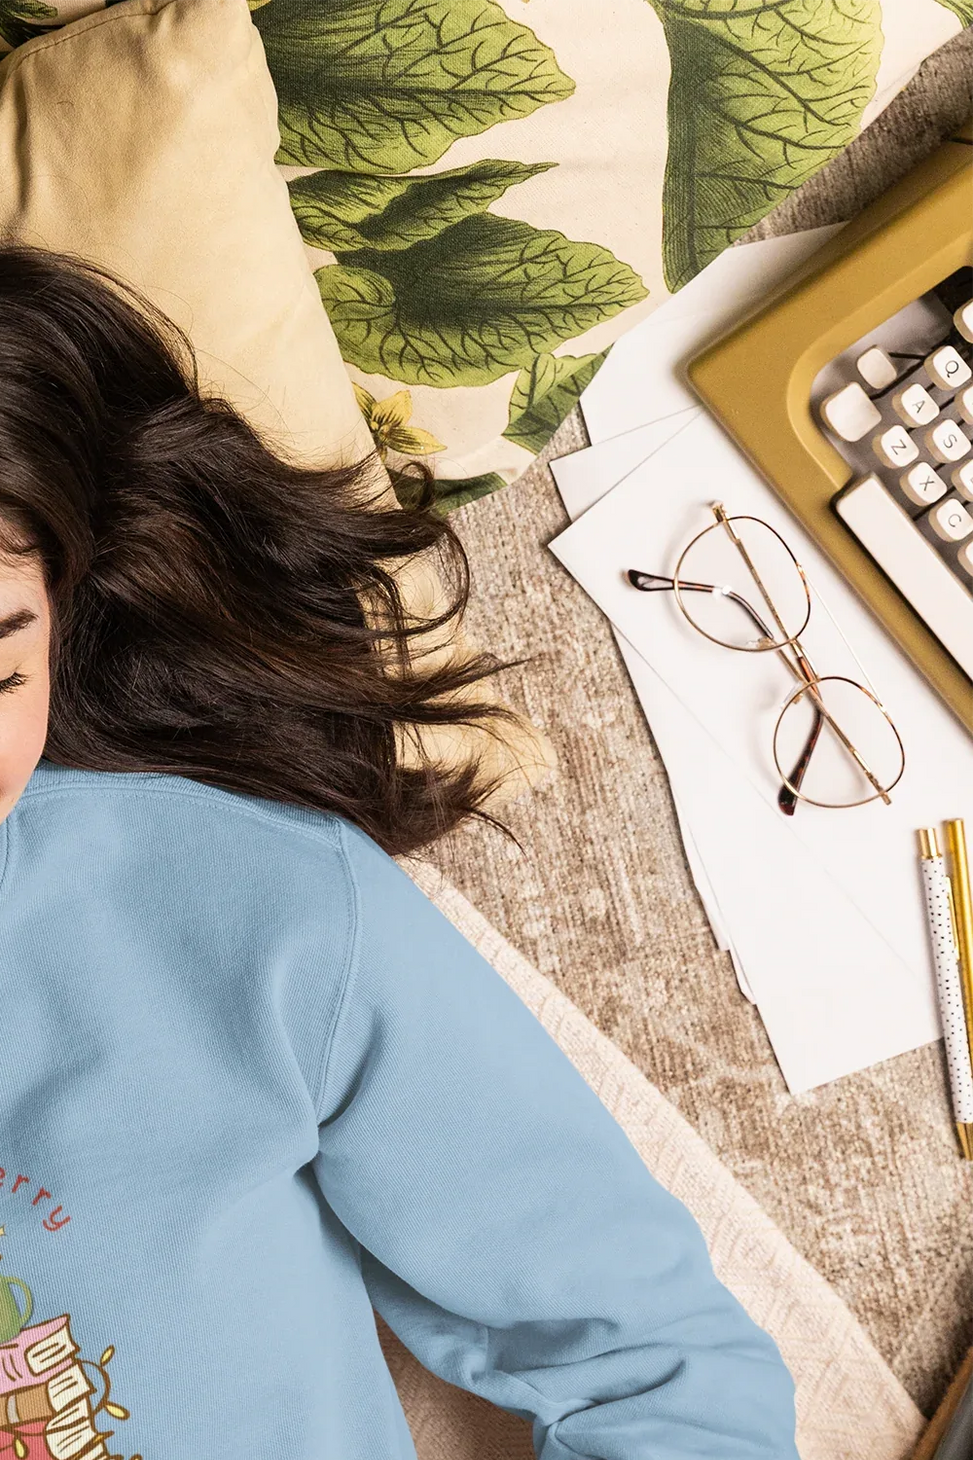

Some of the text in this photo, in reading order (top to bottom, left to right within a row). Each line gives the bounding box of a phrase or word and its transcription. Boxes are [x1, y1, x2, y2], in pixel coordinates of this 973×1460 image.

[944, 359, 960, 379] Q
[911, 399, 958, 449] A S
[890, 438, 962, 528] Z X C
